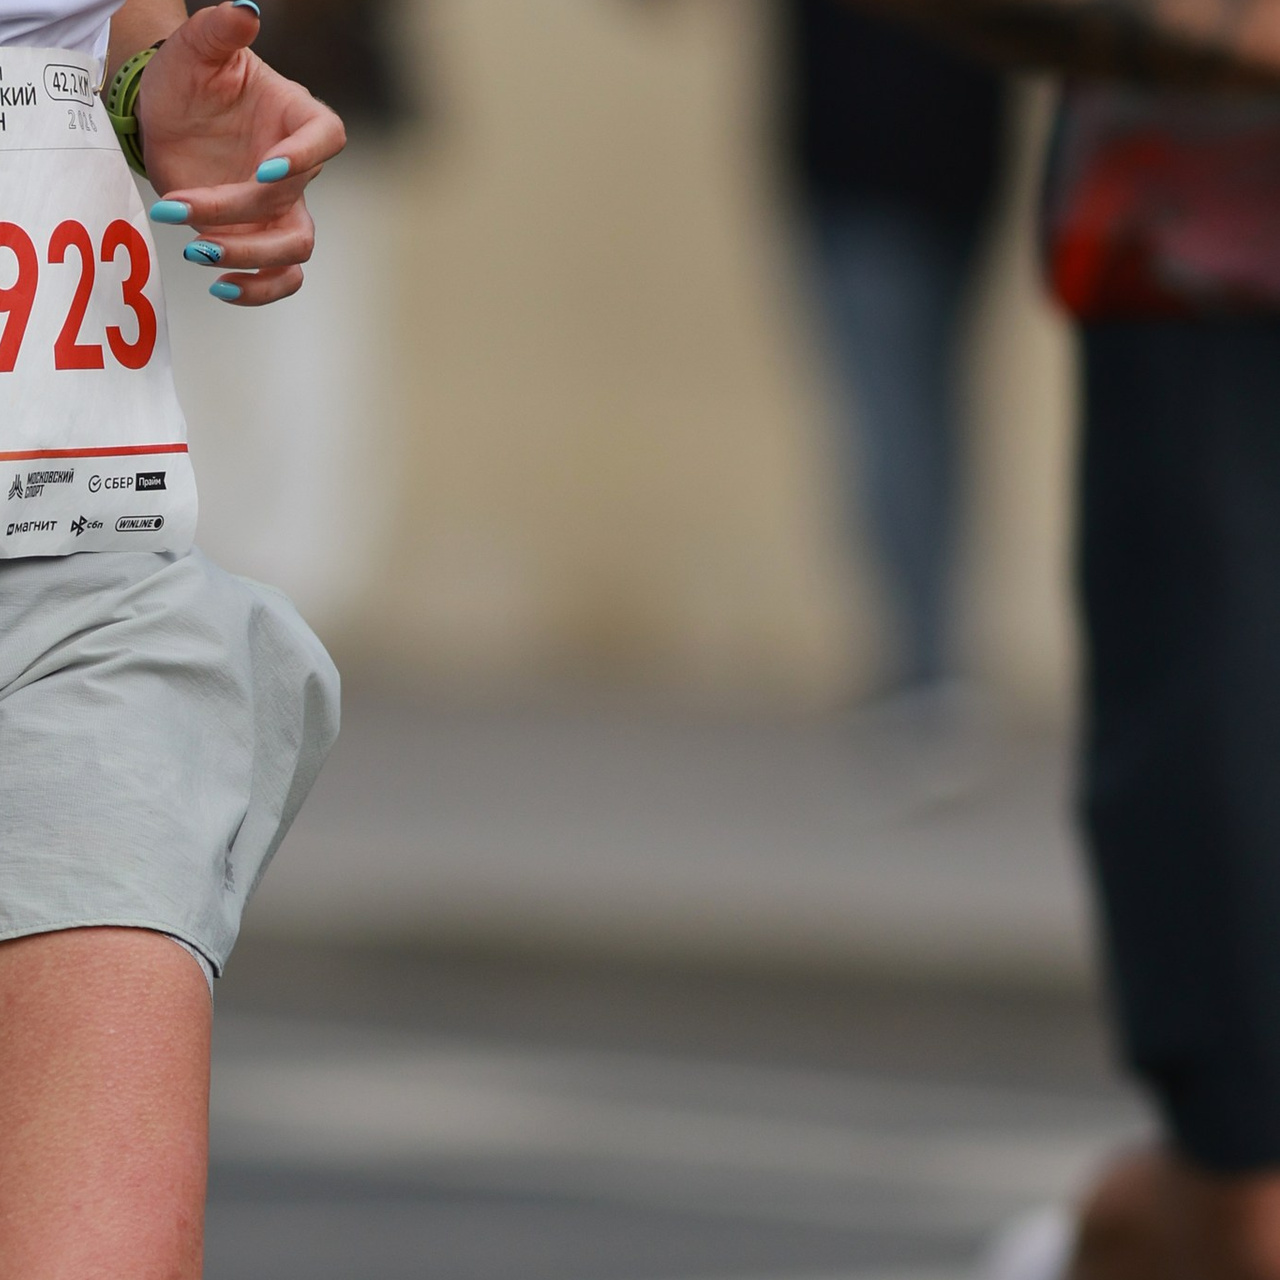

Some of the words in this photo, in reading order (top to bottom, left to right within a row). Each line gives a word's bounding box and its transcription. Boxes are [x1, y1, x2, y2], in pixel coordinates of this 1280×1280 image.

[26, 468, 74, 486] МОСКОВСКИЙ
[104, 477, 134, 489] СБЕР
[119, 518, 153, 529] WINLINE
